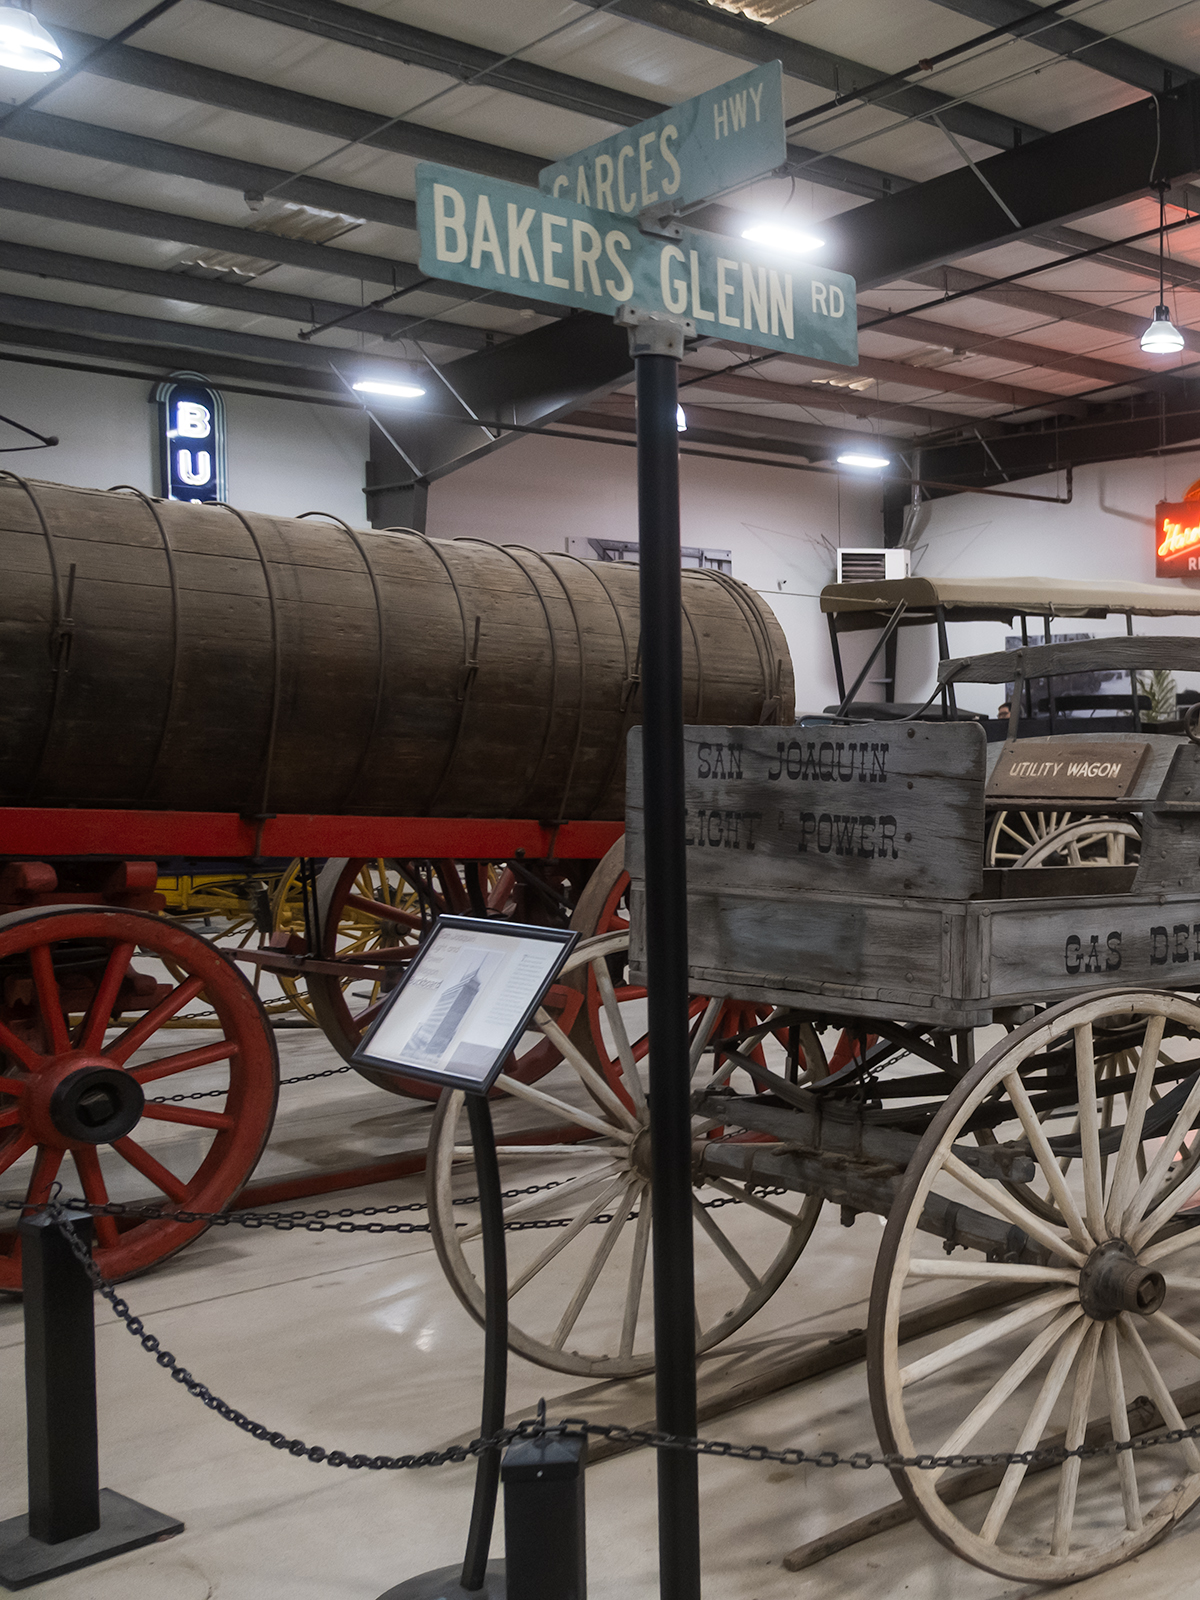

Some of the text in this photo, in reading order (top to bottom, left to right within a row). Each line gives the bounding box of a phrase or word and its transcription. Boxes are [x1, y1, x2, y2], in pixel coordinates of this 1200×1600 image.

[713, 82, 765, 141] HWY
[432, 183, 846, 340] BAKERS GLENN RD
[176, 401, 211, 504] BU
[697, 741, 890, 783] SAN JOAQUIN
[1009, 761, 1122, 778] UTILITY WAGON
[797, 811, 899, 860] POWER
[1064, 931, 1123, 975] GAS
